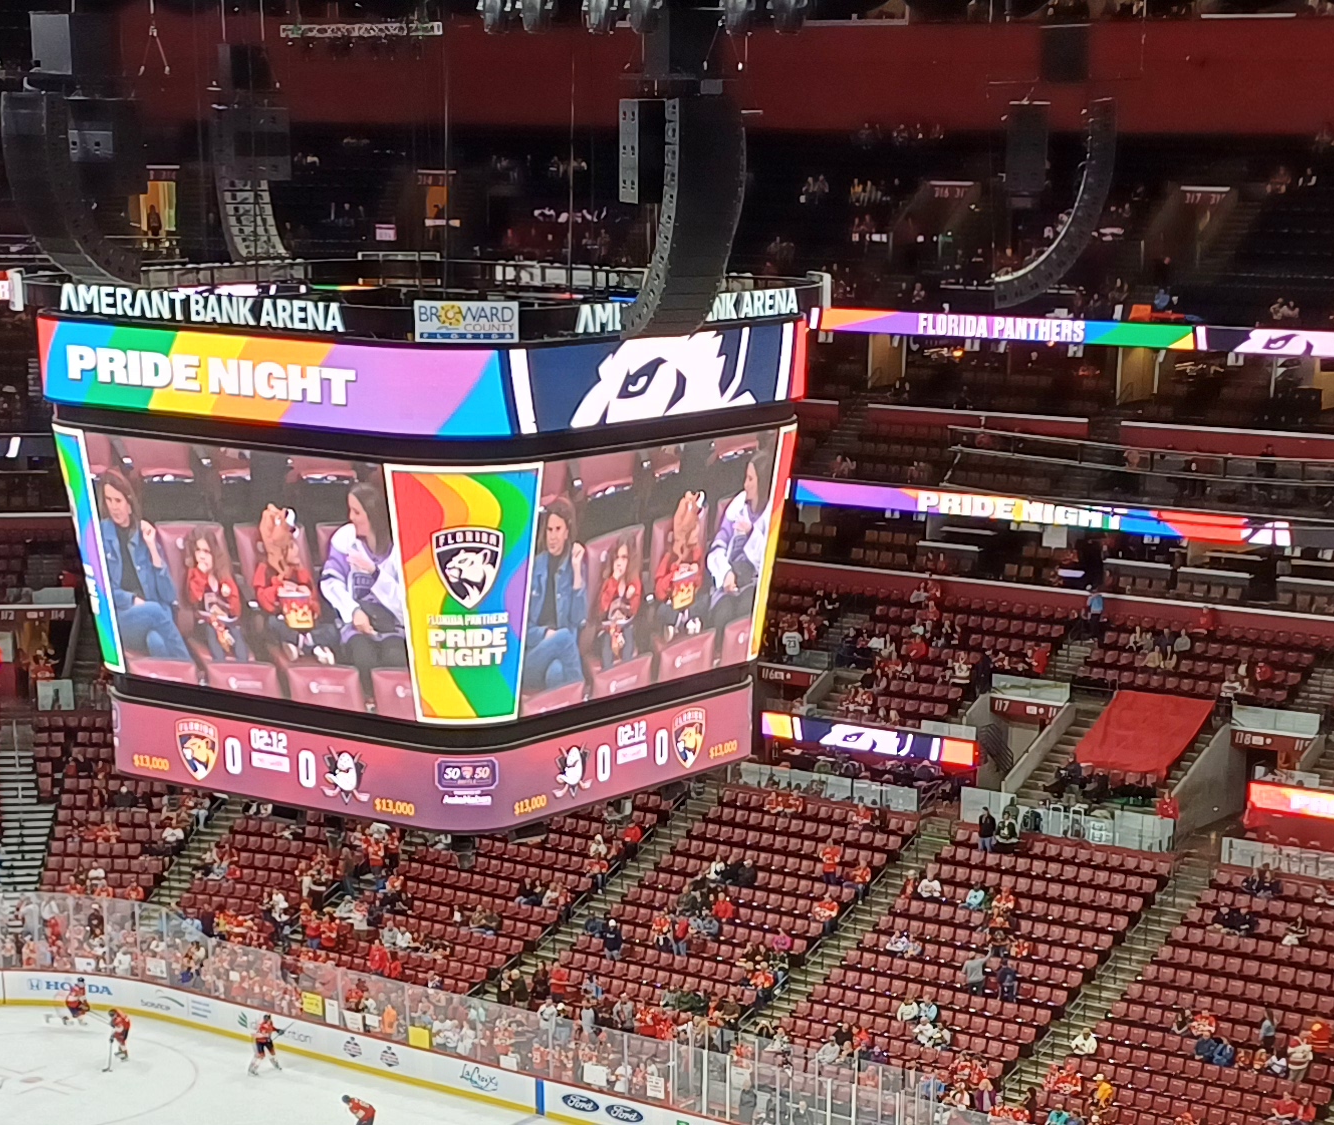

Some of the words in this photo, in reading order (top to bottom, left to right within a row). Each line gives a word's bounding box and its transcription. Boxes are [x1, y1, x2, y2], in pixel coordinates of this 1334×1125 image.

[59, 283, 186, 320] AMERANT
[188, 294, 255, 326] BANK
[259, 299, 347, 333] ARENA
[738, 288, 798, 318] ARENA
[418, 304, 514, 325] BROWARD
[464, 323, 514, 331] COUNTY
[917, 313, 988, 339] FLORIDA
[992, 316, 1085, 344] PANTHERS
[66, 345, 202, 393] PRIDE
[208, 359, 356, 406] NIGHT
[917, 490, 1015, 519] PRIDE
[1021, 500, 1122, 530] NIGHT
[438, 530, 498, 547] FLORIDA
[427, 627, 508, 648] PRIDE
[430, 646, 507, 667] NIGHT
[249, 728, 289, 755] 02:12
[616, 719, 647, 746] 02:12
[225, 737, 243, 775] 0
[654, 728, 668, 766] 0
[708, 738, 738, 760] $13,000
[133, 753, 170, 771] $13,000
[298, 749, 317, 788] 0
[473, 766, 491, 779] 50
[596, 744, 611, 782] 0
[443, 766, 460, 780] 50
[374, 797, 415, 816] $13,000
[513, 795, 547, 815] $13,000
[46, 981, 113, 996] HODA
[566, 1095, 595, 1112] Ford
[610, 1105, 639, 1122] Ford
